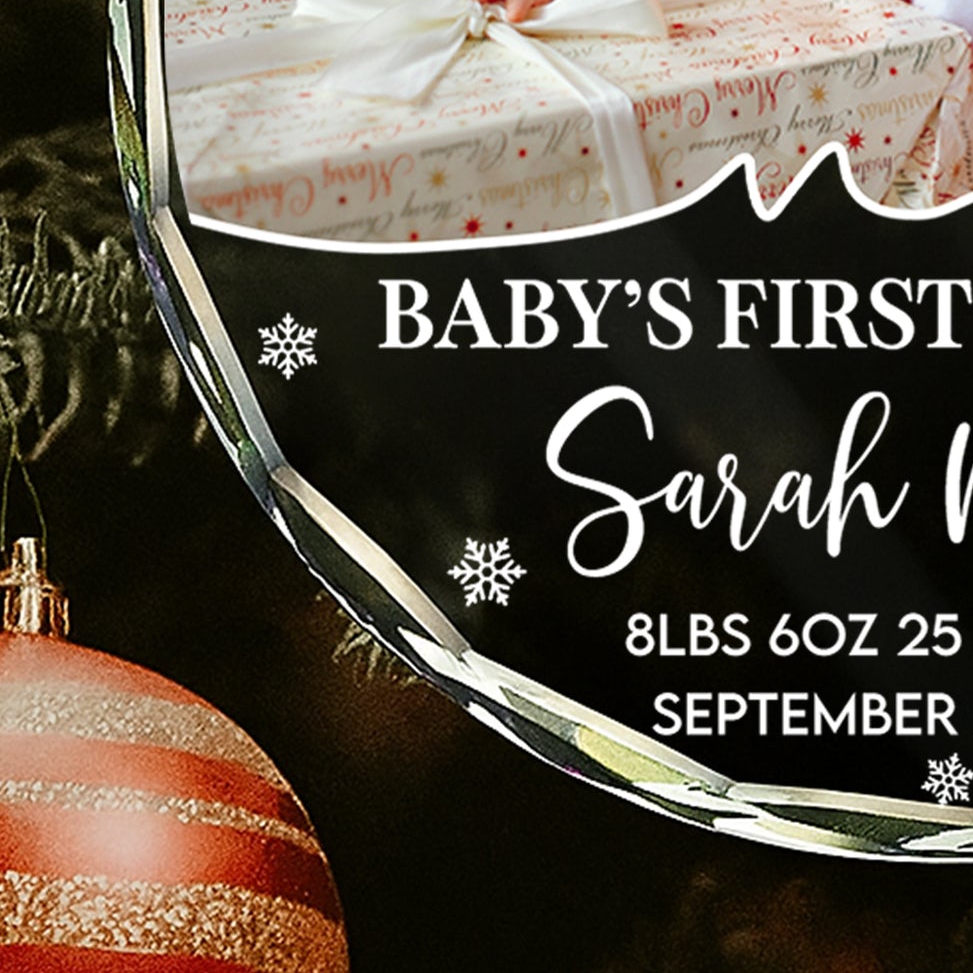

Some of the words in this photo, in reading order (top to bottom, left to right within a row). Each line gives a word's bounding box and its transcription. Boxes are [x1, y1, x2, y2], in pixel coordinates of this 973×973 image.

[632, 88, 711, 131] Christ
[713, 70, 797, 117] Merry
[322, 153, 416, 204] Merry
[716, 277, 973, 351] FIRST
[545, 385, 910, 578] Sarah
[625, 612, 752, 657] 8LBS
[768, 612, 879, 657] 6OZ
[897, 612, 962, 657] 25
[652, 691, 958, 736] SEPTEMBER
